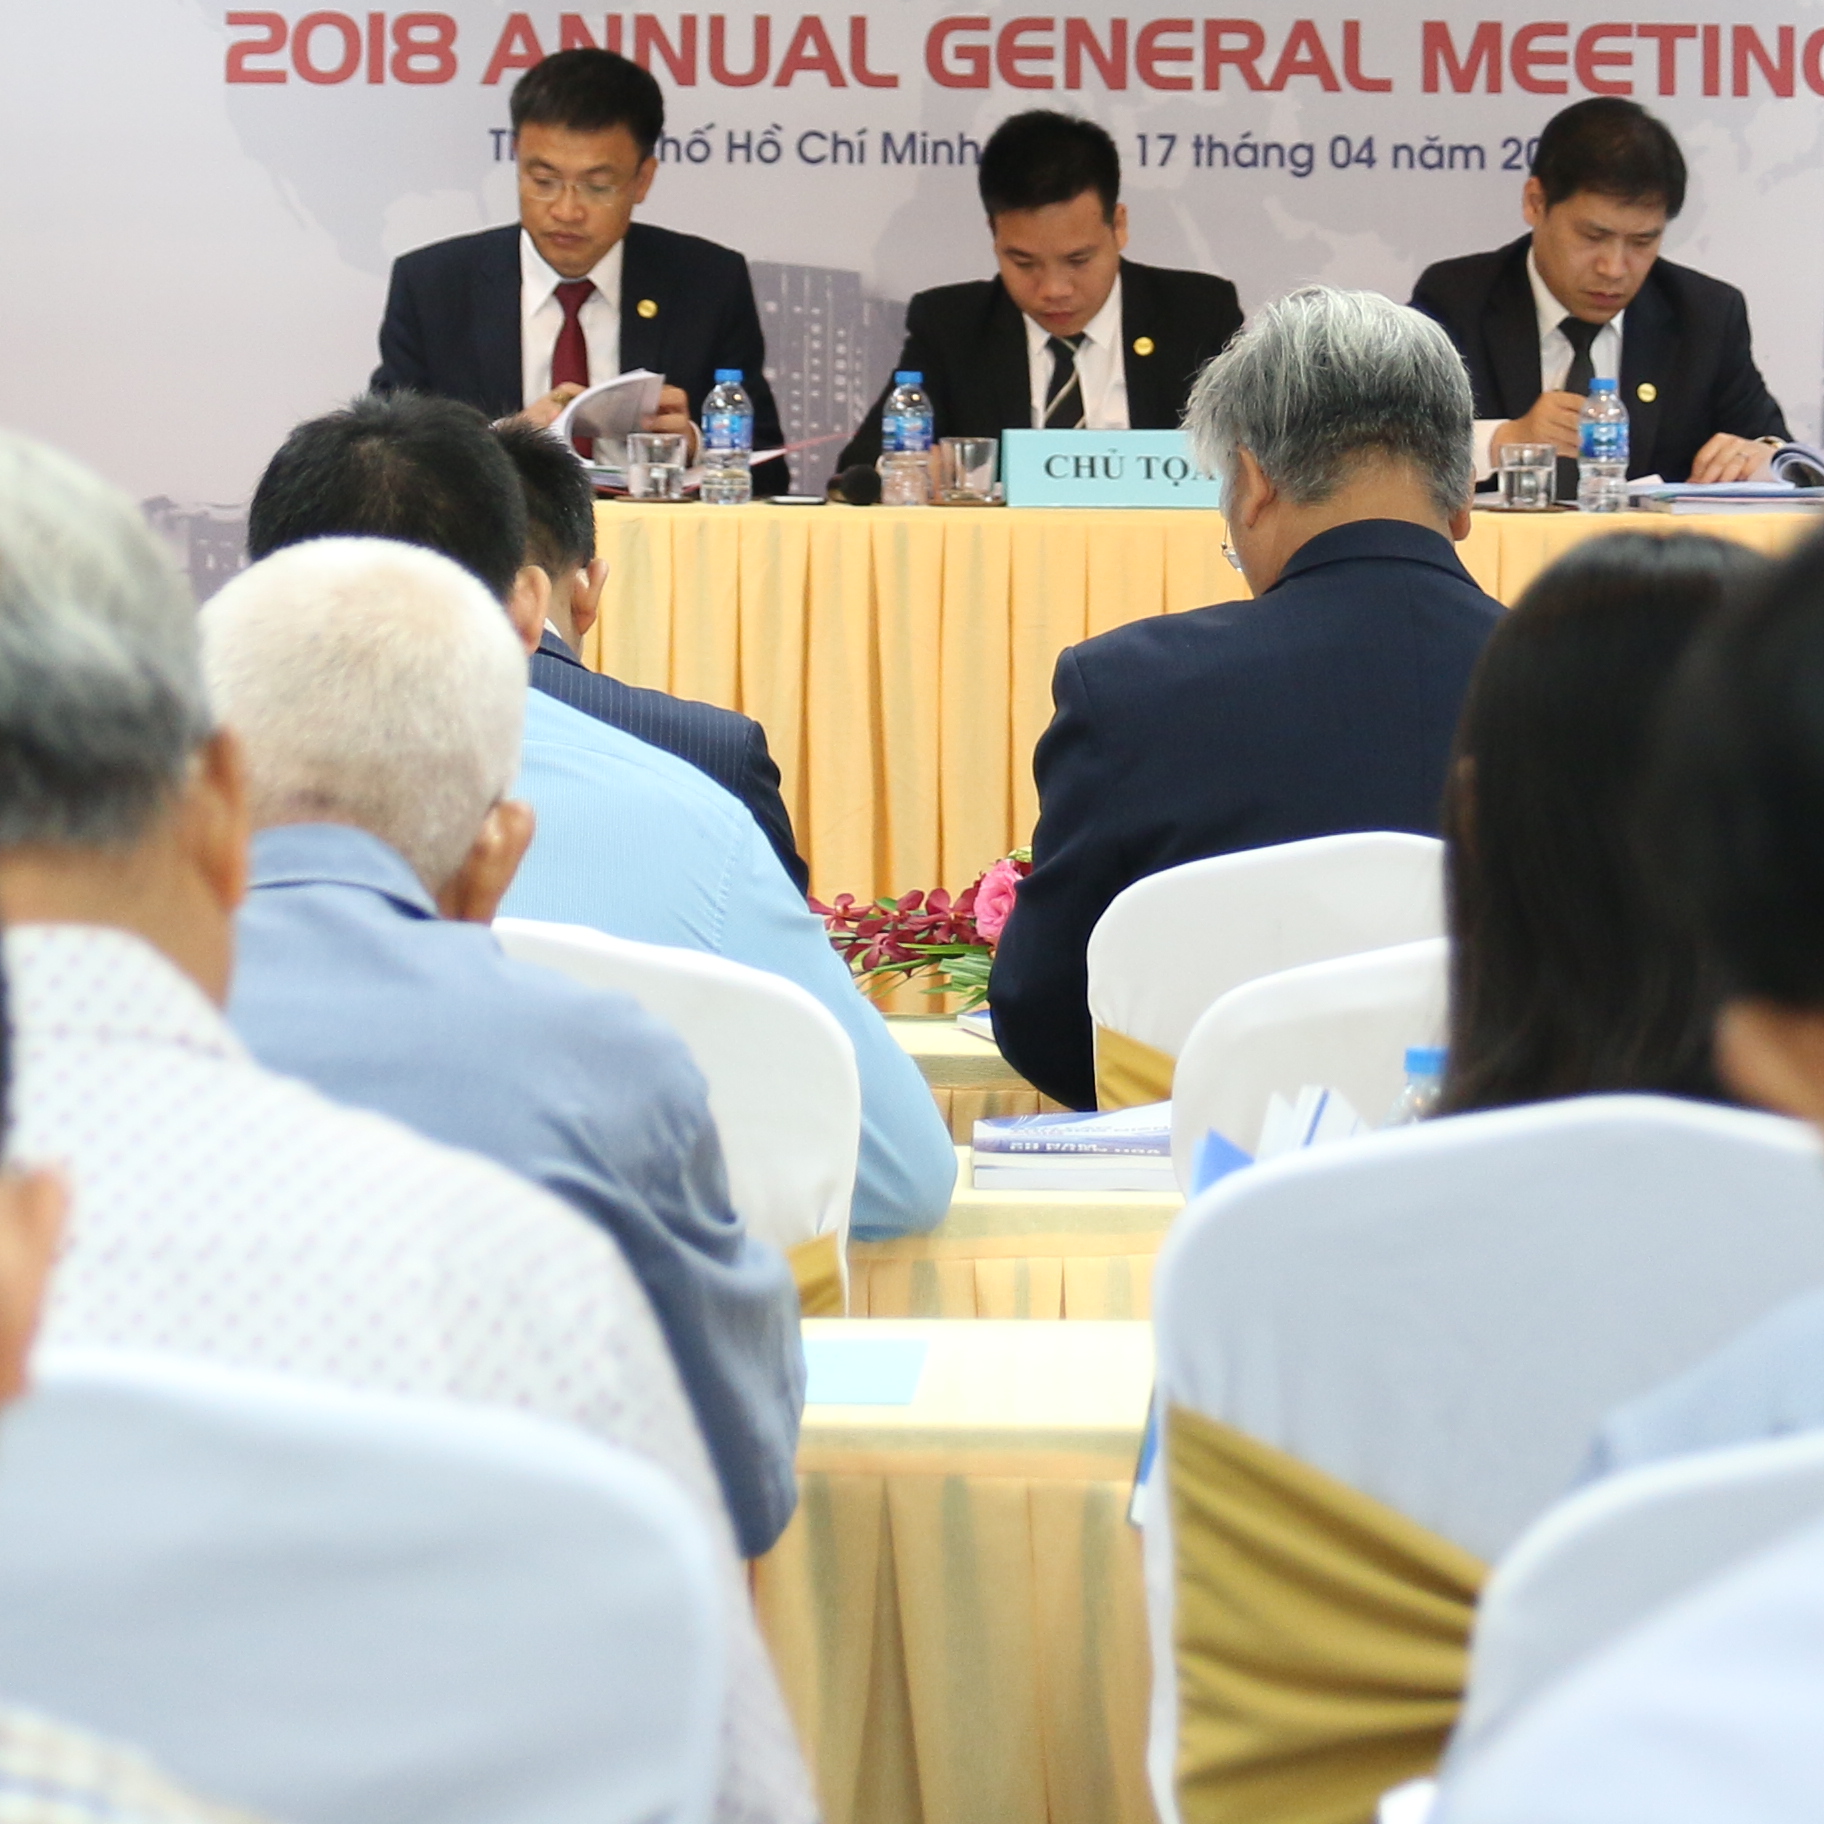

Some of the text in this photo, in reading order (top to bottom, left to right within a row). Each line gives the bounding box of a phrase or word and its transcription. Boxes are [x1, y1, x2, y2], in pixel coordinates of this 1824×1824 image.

[224, 10, 460, 87] 2018
[923, 15, 1395, 95] GENERAL
[659, 122, 715, 164] hố
[726, 123, 783, 165] Hồ
[797, 127, 869, 165] Chí
[880, 131, 984, 166] Minh
[1135, 133, 1177, 167] 17
[1192, 131, 1315, 177] tháng
[1329, 135, 1378, 170] 04
[1391, 136, 1486, 171] năm
[1044, 448, 1217, 487] CHỦ TỌ
